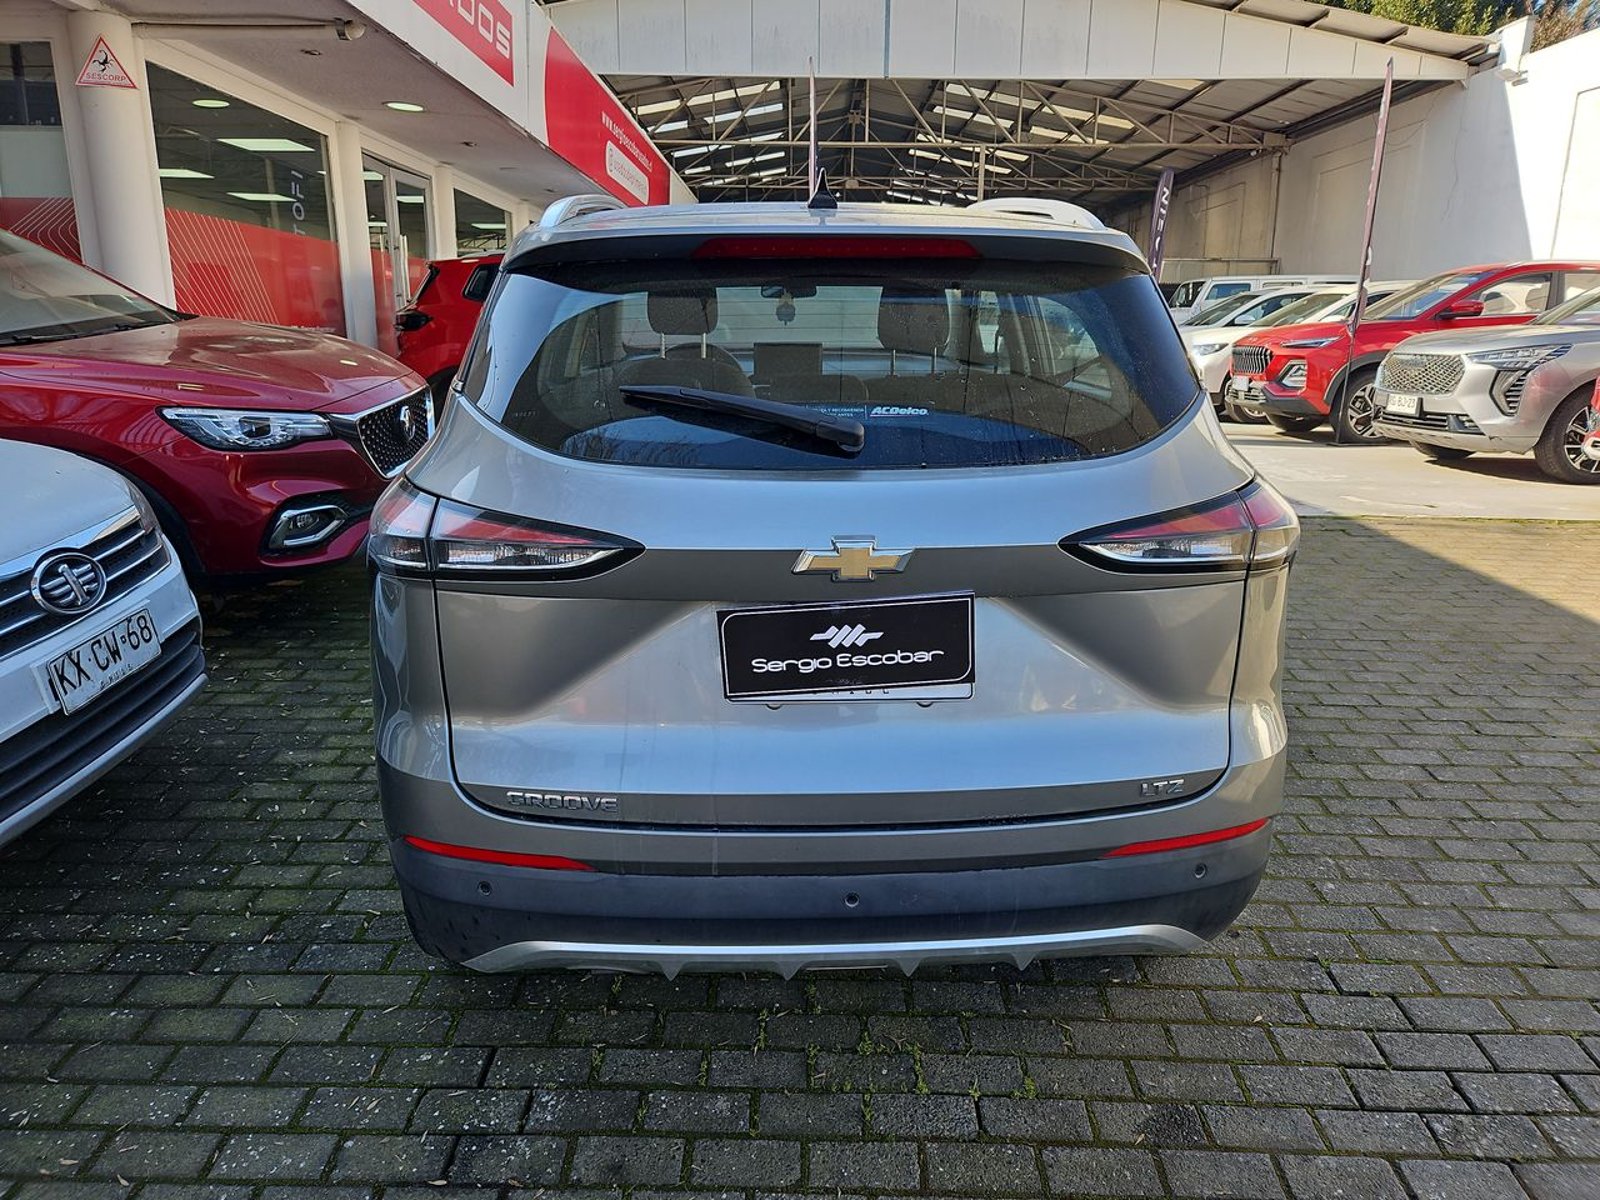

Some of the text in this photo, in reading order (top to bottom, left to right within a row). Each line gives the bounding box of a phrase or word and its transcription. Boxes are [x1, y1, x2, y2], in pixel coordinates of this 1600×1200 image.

[449, 0, 511, 59] DOS
[86, 72, 126, 81] SESCORP
[751, 650, 944, 674] Sergio Escobar
[1141, 779, 1185, 796] LTZ
[506, 791, 618, 812] GROOVE
